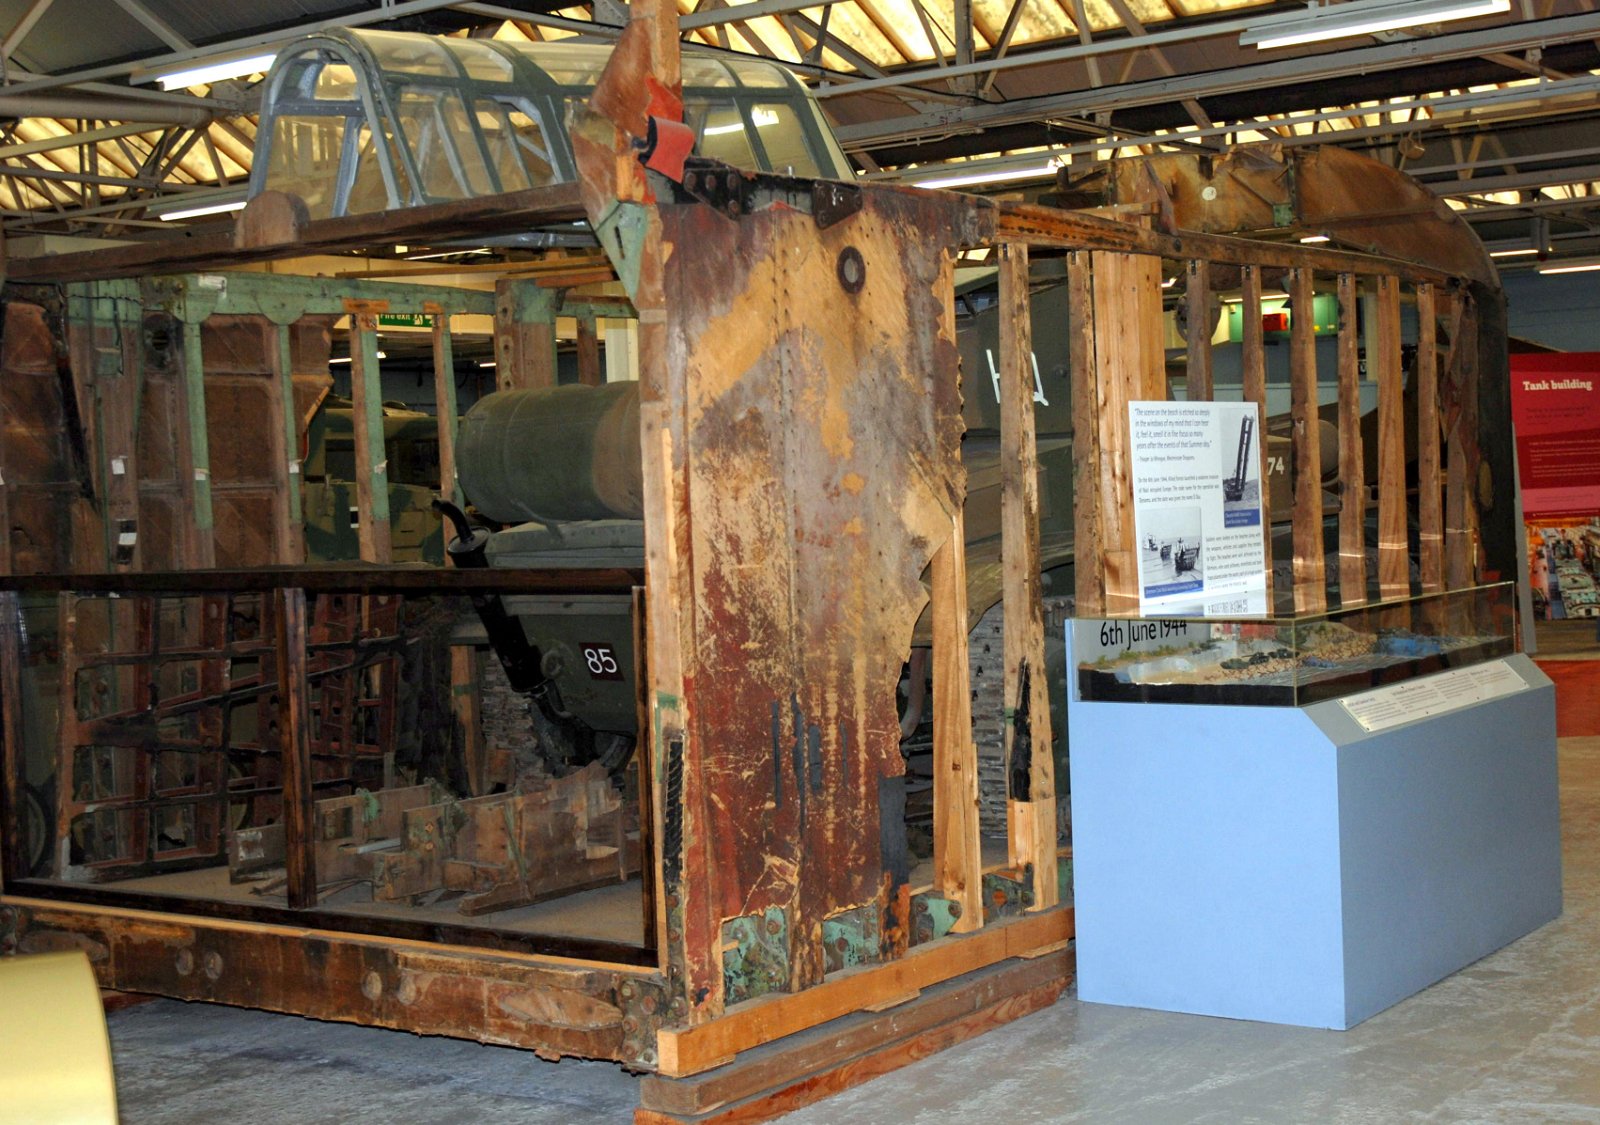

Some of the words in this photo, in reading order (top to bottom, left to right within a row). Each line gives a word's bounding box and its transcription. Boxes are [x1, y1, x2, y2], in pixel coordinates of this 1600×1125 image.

[1522, 380, 1550, 391] Tank
[1550, 378, 1593, 391] building
[1100, 620, 1123, 647] 6th
[1127, 619, 1157, 651] June
[1160, 620, 1187, 638] 1944
[584, 648, 617, 674] 85
